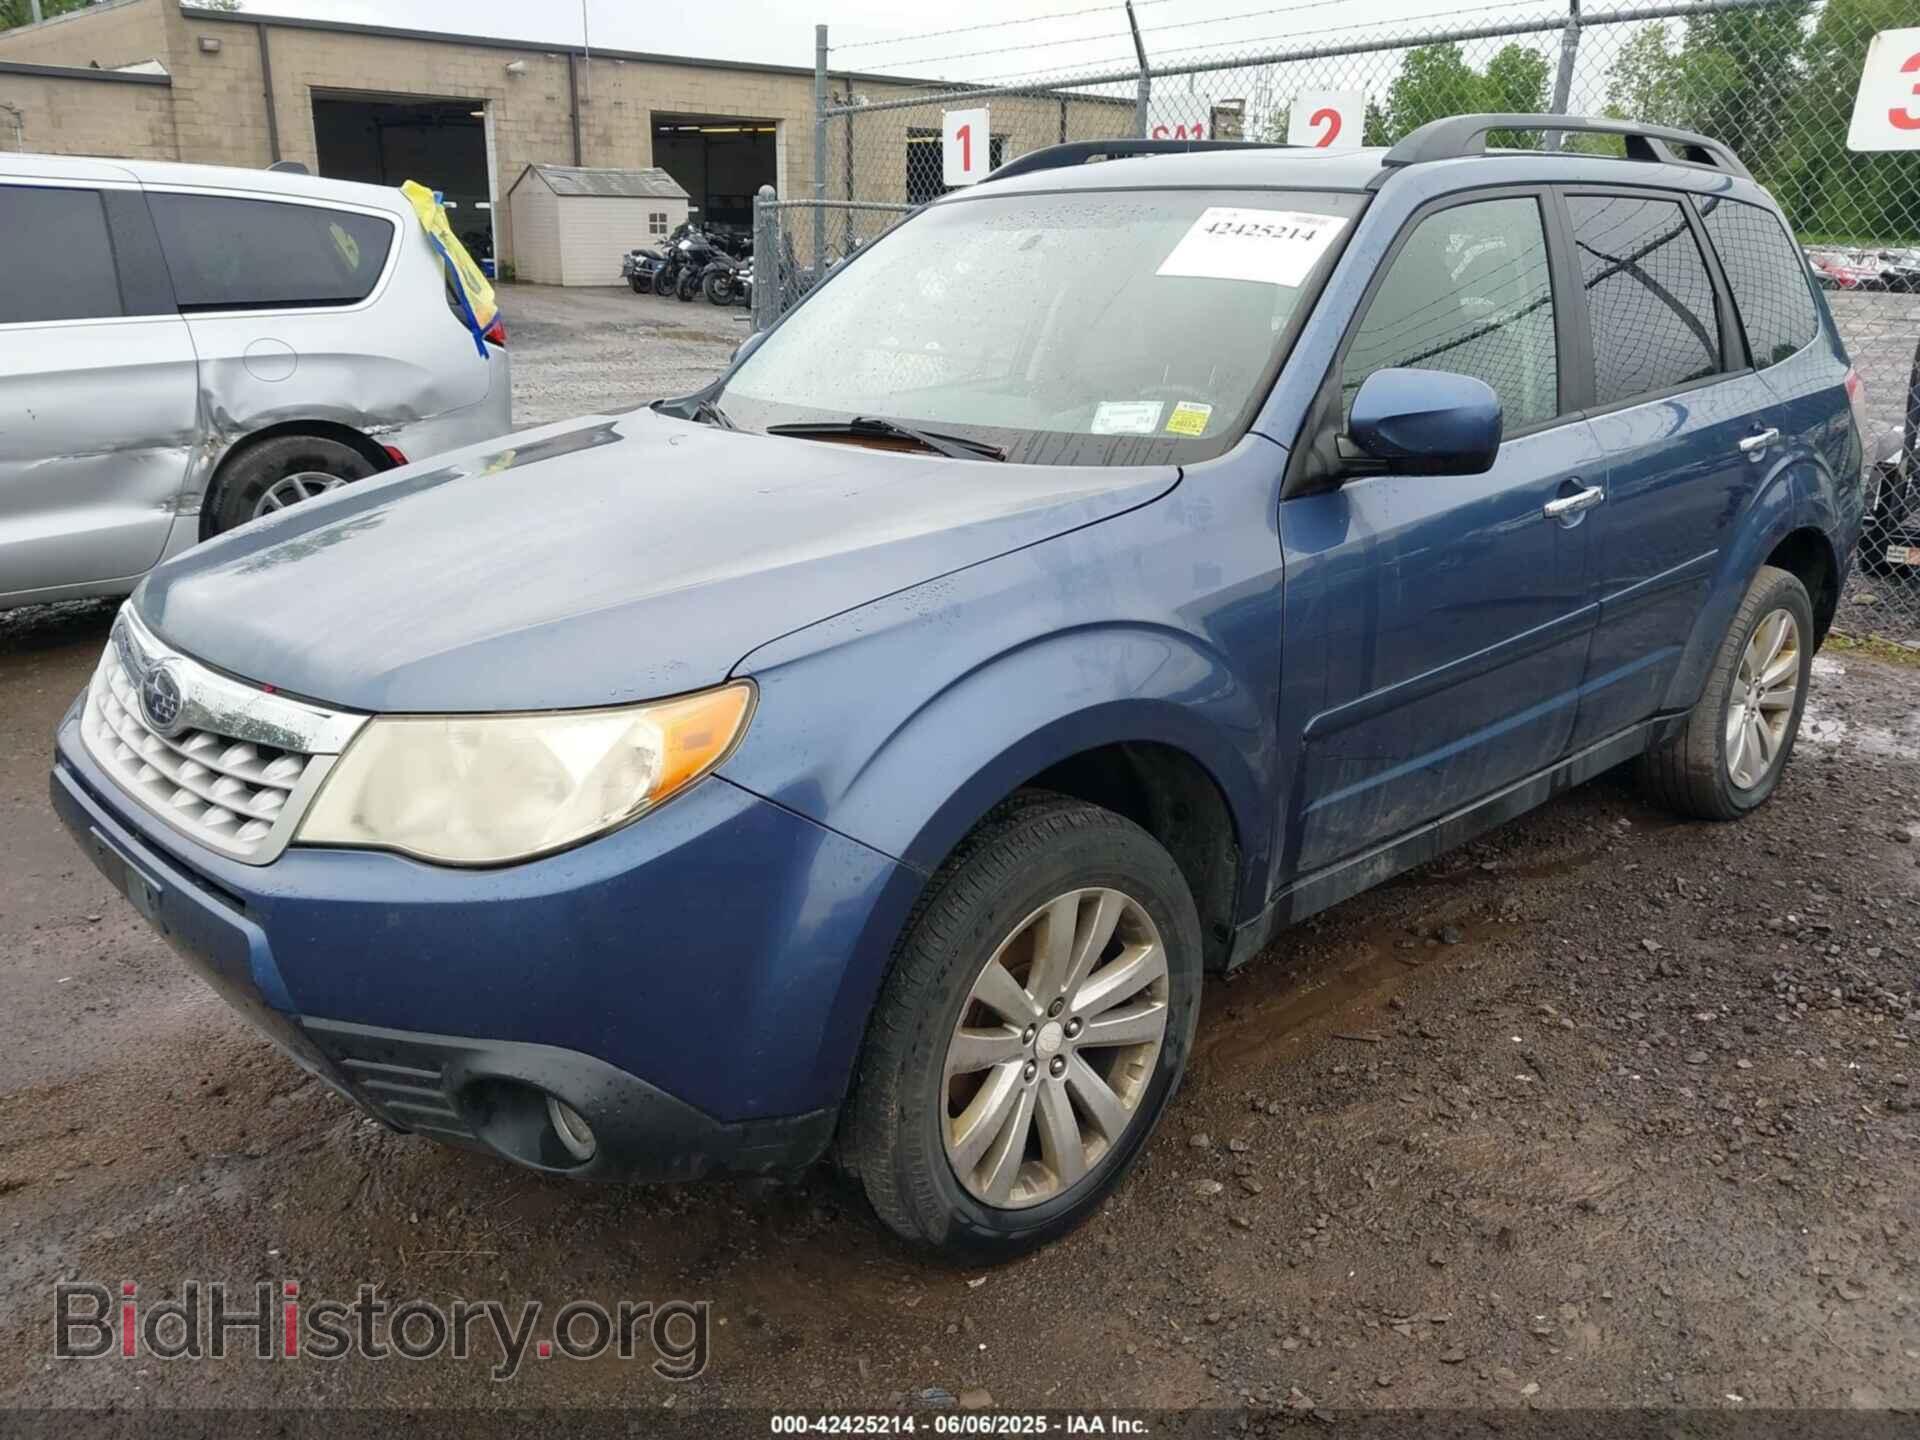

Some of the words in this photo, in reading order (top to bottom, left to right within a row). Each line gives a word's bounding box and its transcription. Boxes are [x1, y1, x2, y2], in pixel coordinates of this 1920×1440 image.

[956, 124, 971, 172] 1
[1310, 108, 1342, 148] 2
[1204, 221, 1317, 241] 42425214
